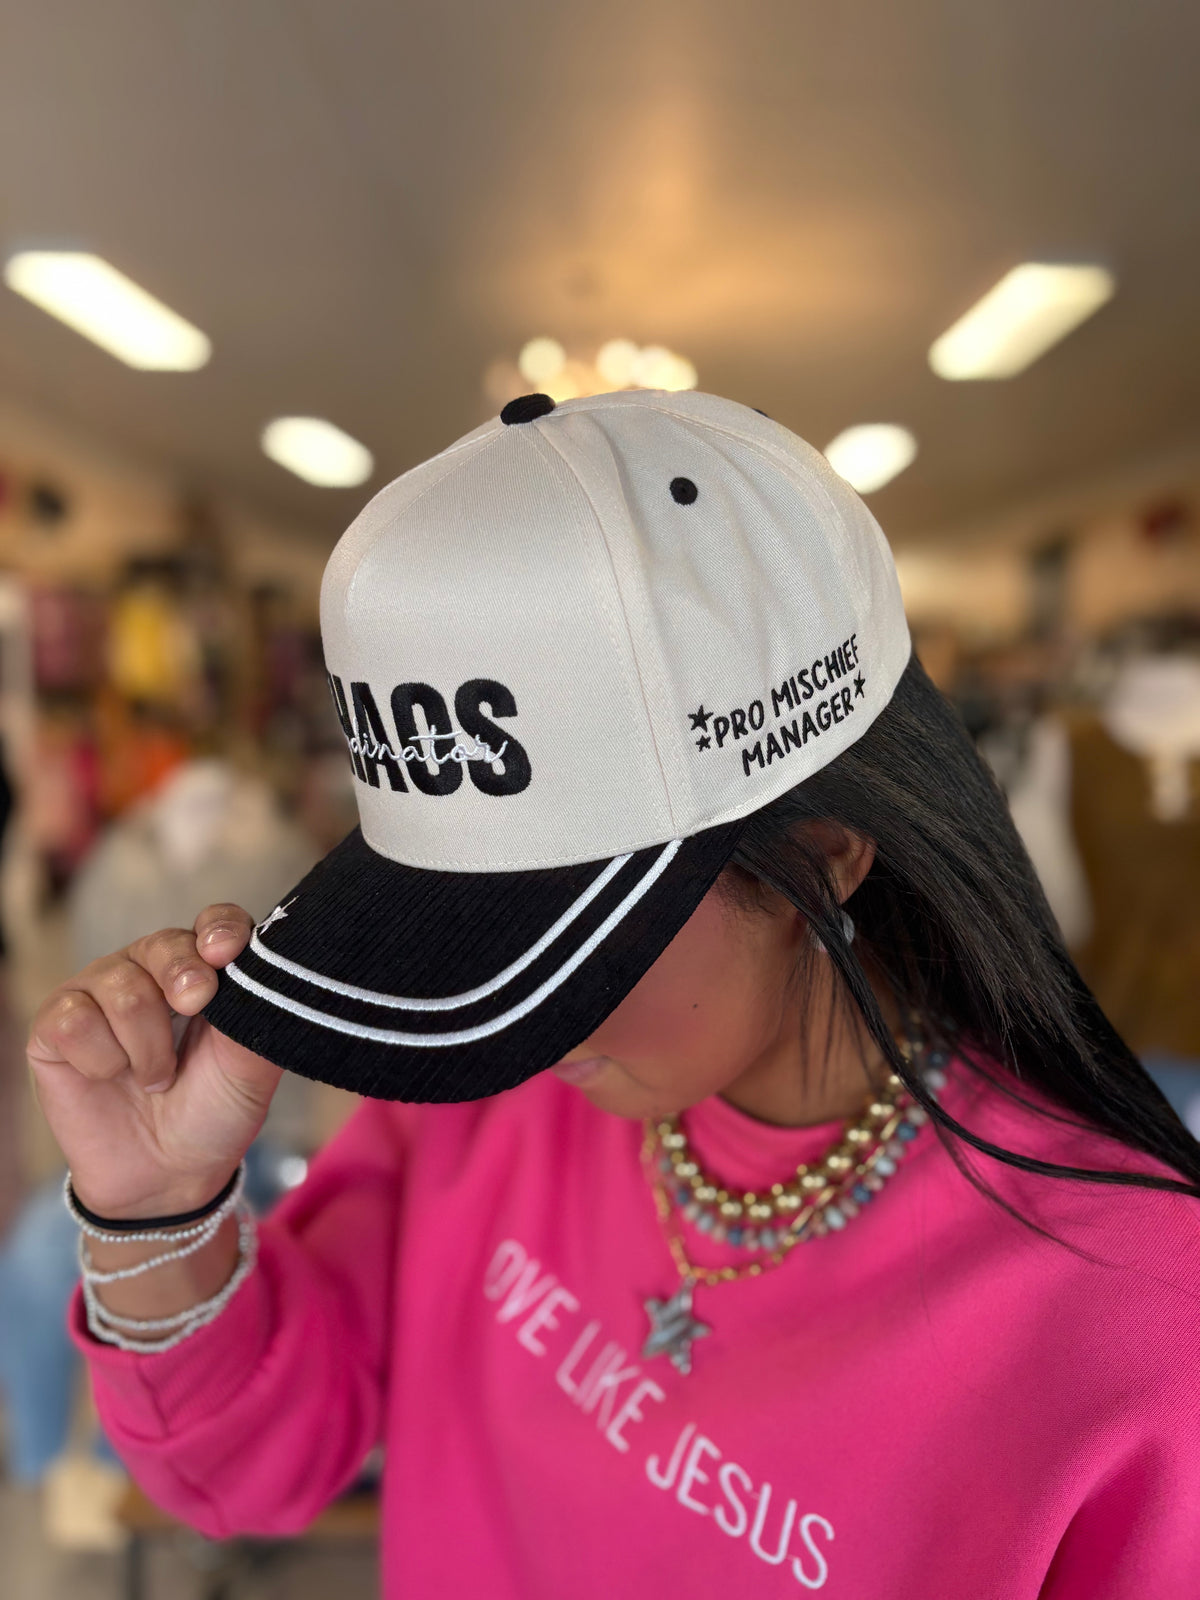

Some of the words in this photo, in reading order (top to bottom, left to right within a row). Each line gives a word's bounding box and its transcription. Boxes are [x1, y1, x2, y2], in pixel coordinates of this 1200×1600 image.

[713, 699, 765, 748] PRO
[771, 633, 859, 717] MISCHIEF
[741, 687, 855, 777] MANAGER
[556, 1319, 666, 1453] LIKE
[645, 1422, 835, 1589] JESUS
